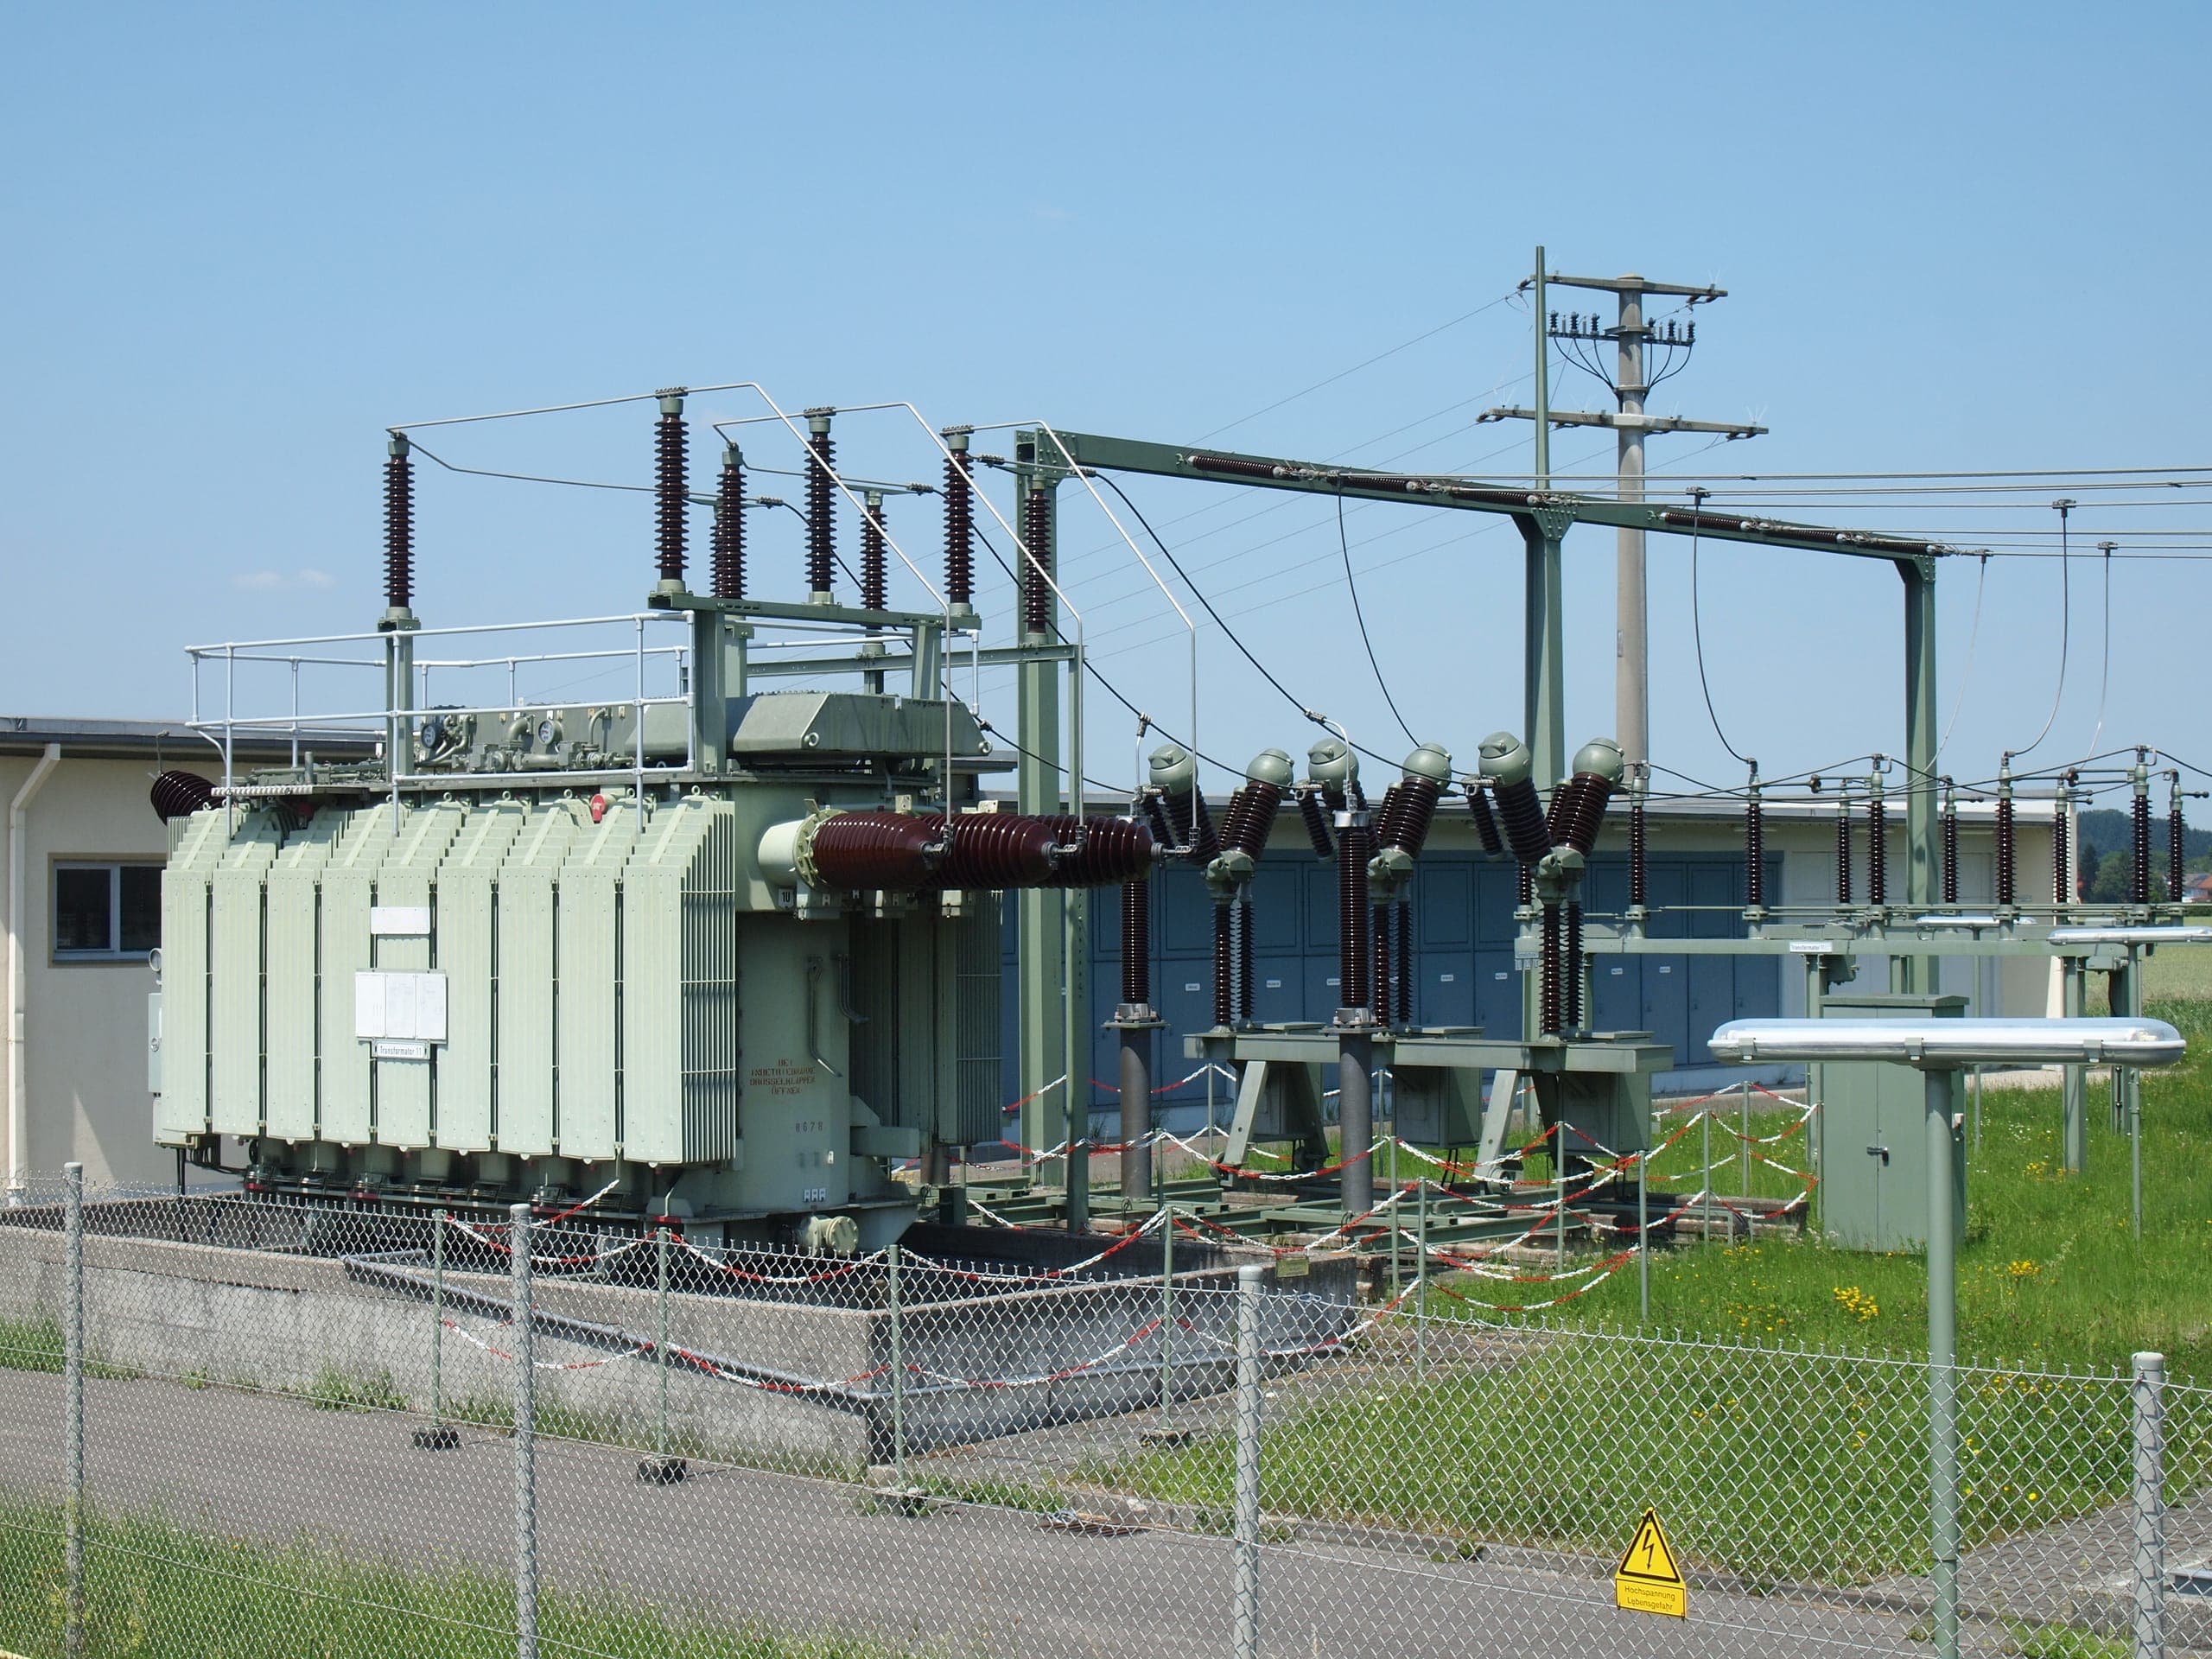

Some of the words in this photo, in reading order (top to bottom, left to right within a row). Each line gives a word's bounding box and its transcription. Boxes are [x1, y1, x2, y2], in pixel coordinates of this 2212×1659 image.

[781, 891, 791, 903] 1U
[380, 1045, 415, 1055] Transformator
[1624, 1586, 1675, 1602] Hochspannung
[1627, 1597, 1674, 1611] Lebensgefahr
